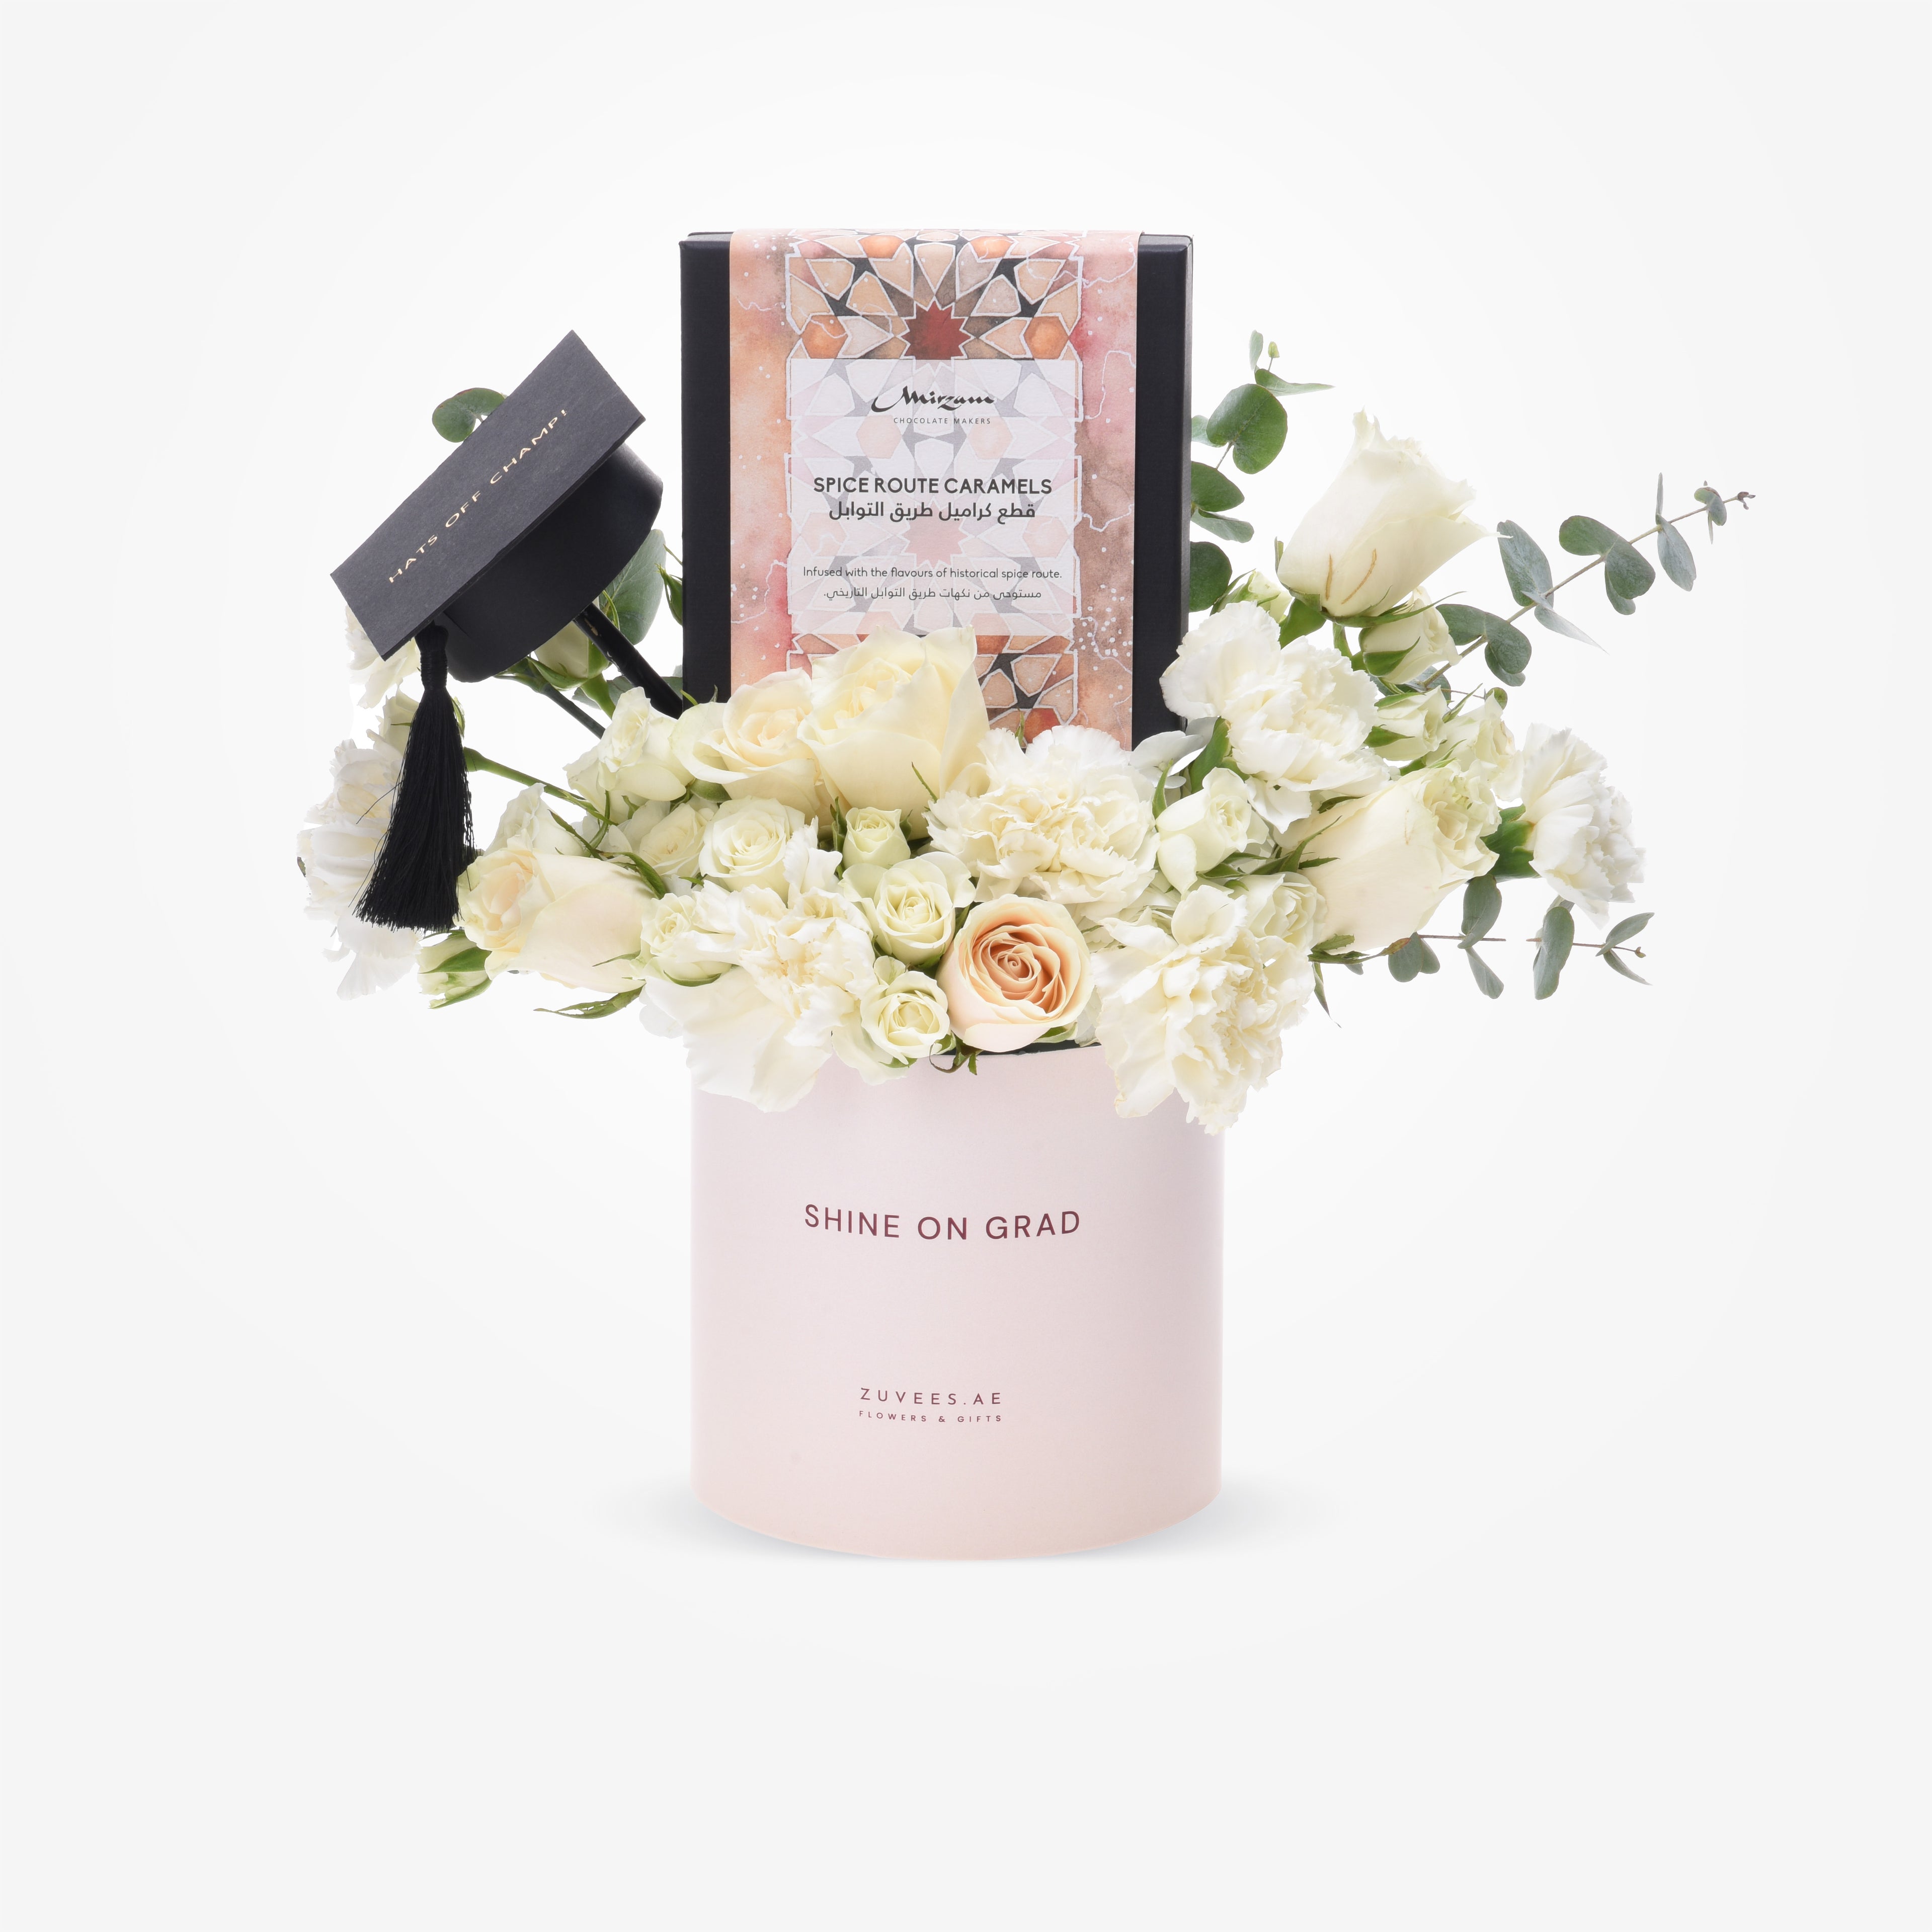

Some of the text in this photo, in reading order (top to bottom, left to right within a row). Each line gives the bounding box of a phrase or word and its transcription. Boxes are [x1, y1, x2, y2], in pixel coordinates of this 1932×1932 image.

[871, 385, 995, 413] Mirzam
[813, 477, 1052, 495] SPICE ROUTE CARAMELS
[389, 409, 567, 583] HATS OFF CHAMP!
[829, 502, 1035, 525] قطع كراميل طريق التوابل
[803, 566, 1063, 581] Infused with the flavours of historical spice route.
[870, 588, 906, 600] التوابل
[908, 588, 936, 600] طريق
[939, 588, 971, 601] نكهات
[974, 590, 991, 600] من
[804, 1204, 1080, 1240] SHINE ON GRAD
[860, 1387, 1001, 1405] ZUVEES.AE
[859, 1410, 926, 1422] FLOWERS
